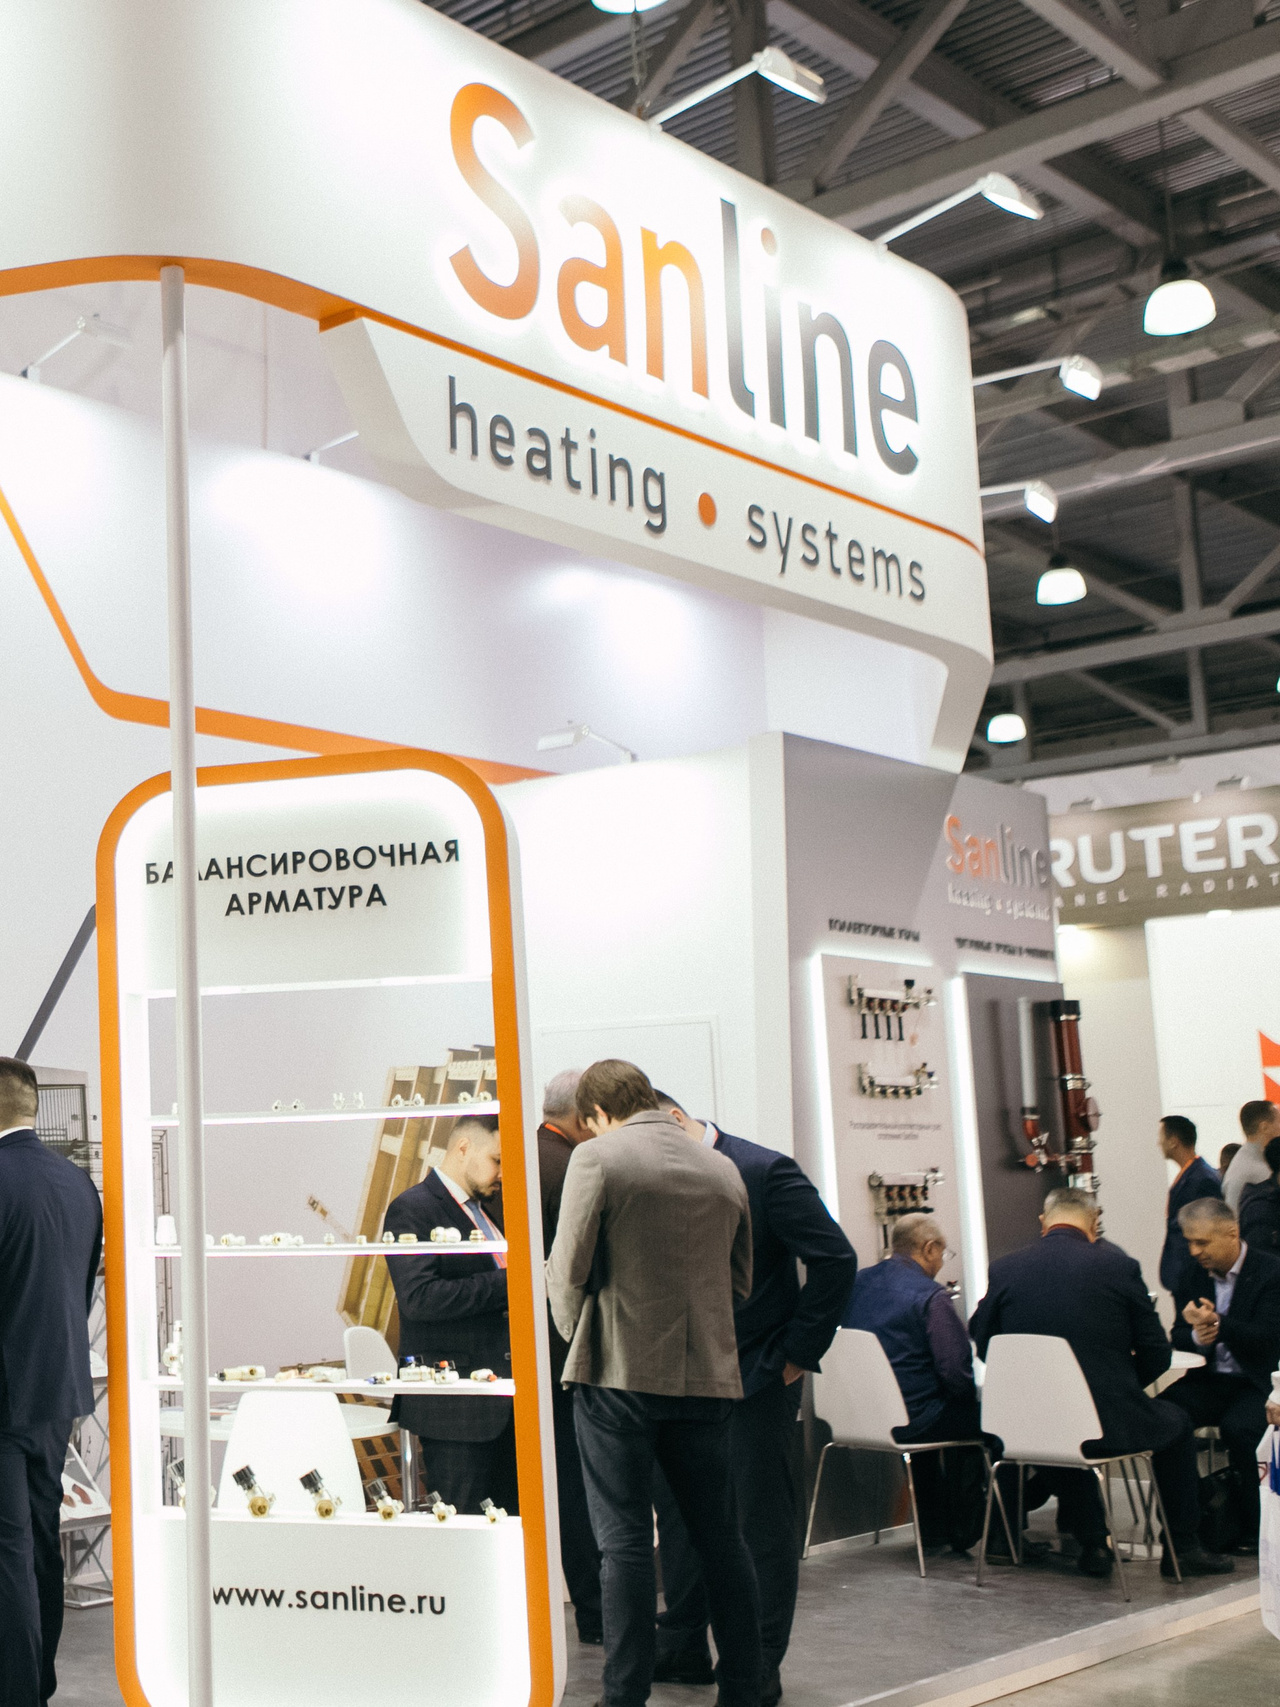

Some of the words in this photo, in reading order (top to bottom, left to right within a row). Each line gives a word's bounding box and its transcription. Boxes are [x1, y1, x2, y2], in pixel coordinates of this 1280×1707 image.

[449, 82, 920, 476] Sanline
[448, 375, 668, 534] heating
[747, 501, 926, 602] systems
[145, 839, 459, 885] БААНСИРОВОЧНАЯ
[944, 813, 1051, 888] Sanline
[225, 883, 387, 917] АРМАТУРА
[212, 1584, 447, 1616] www.sanline.ru
